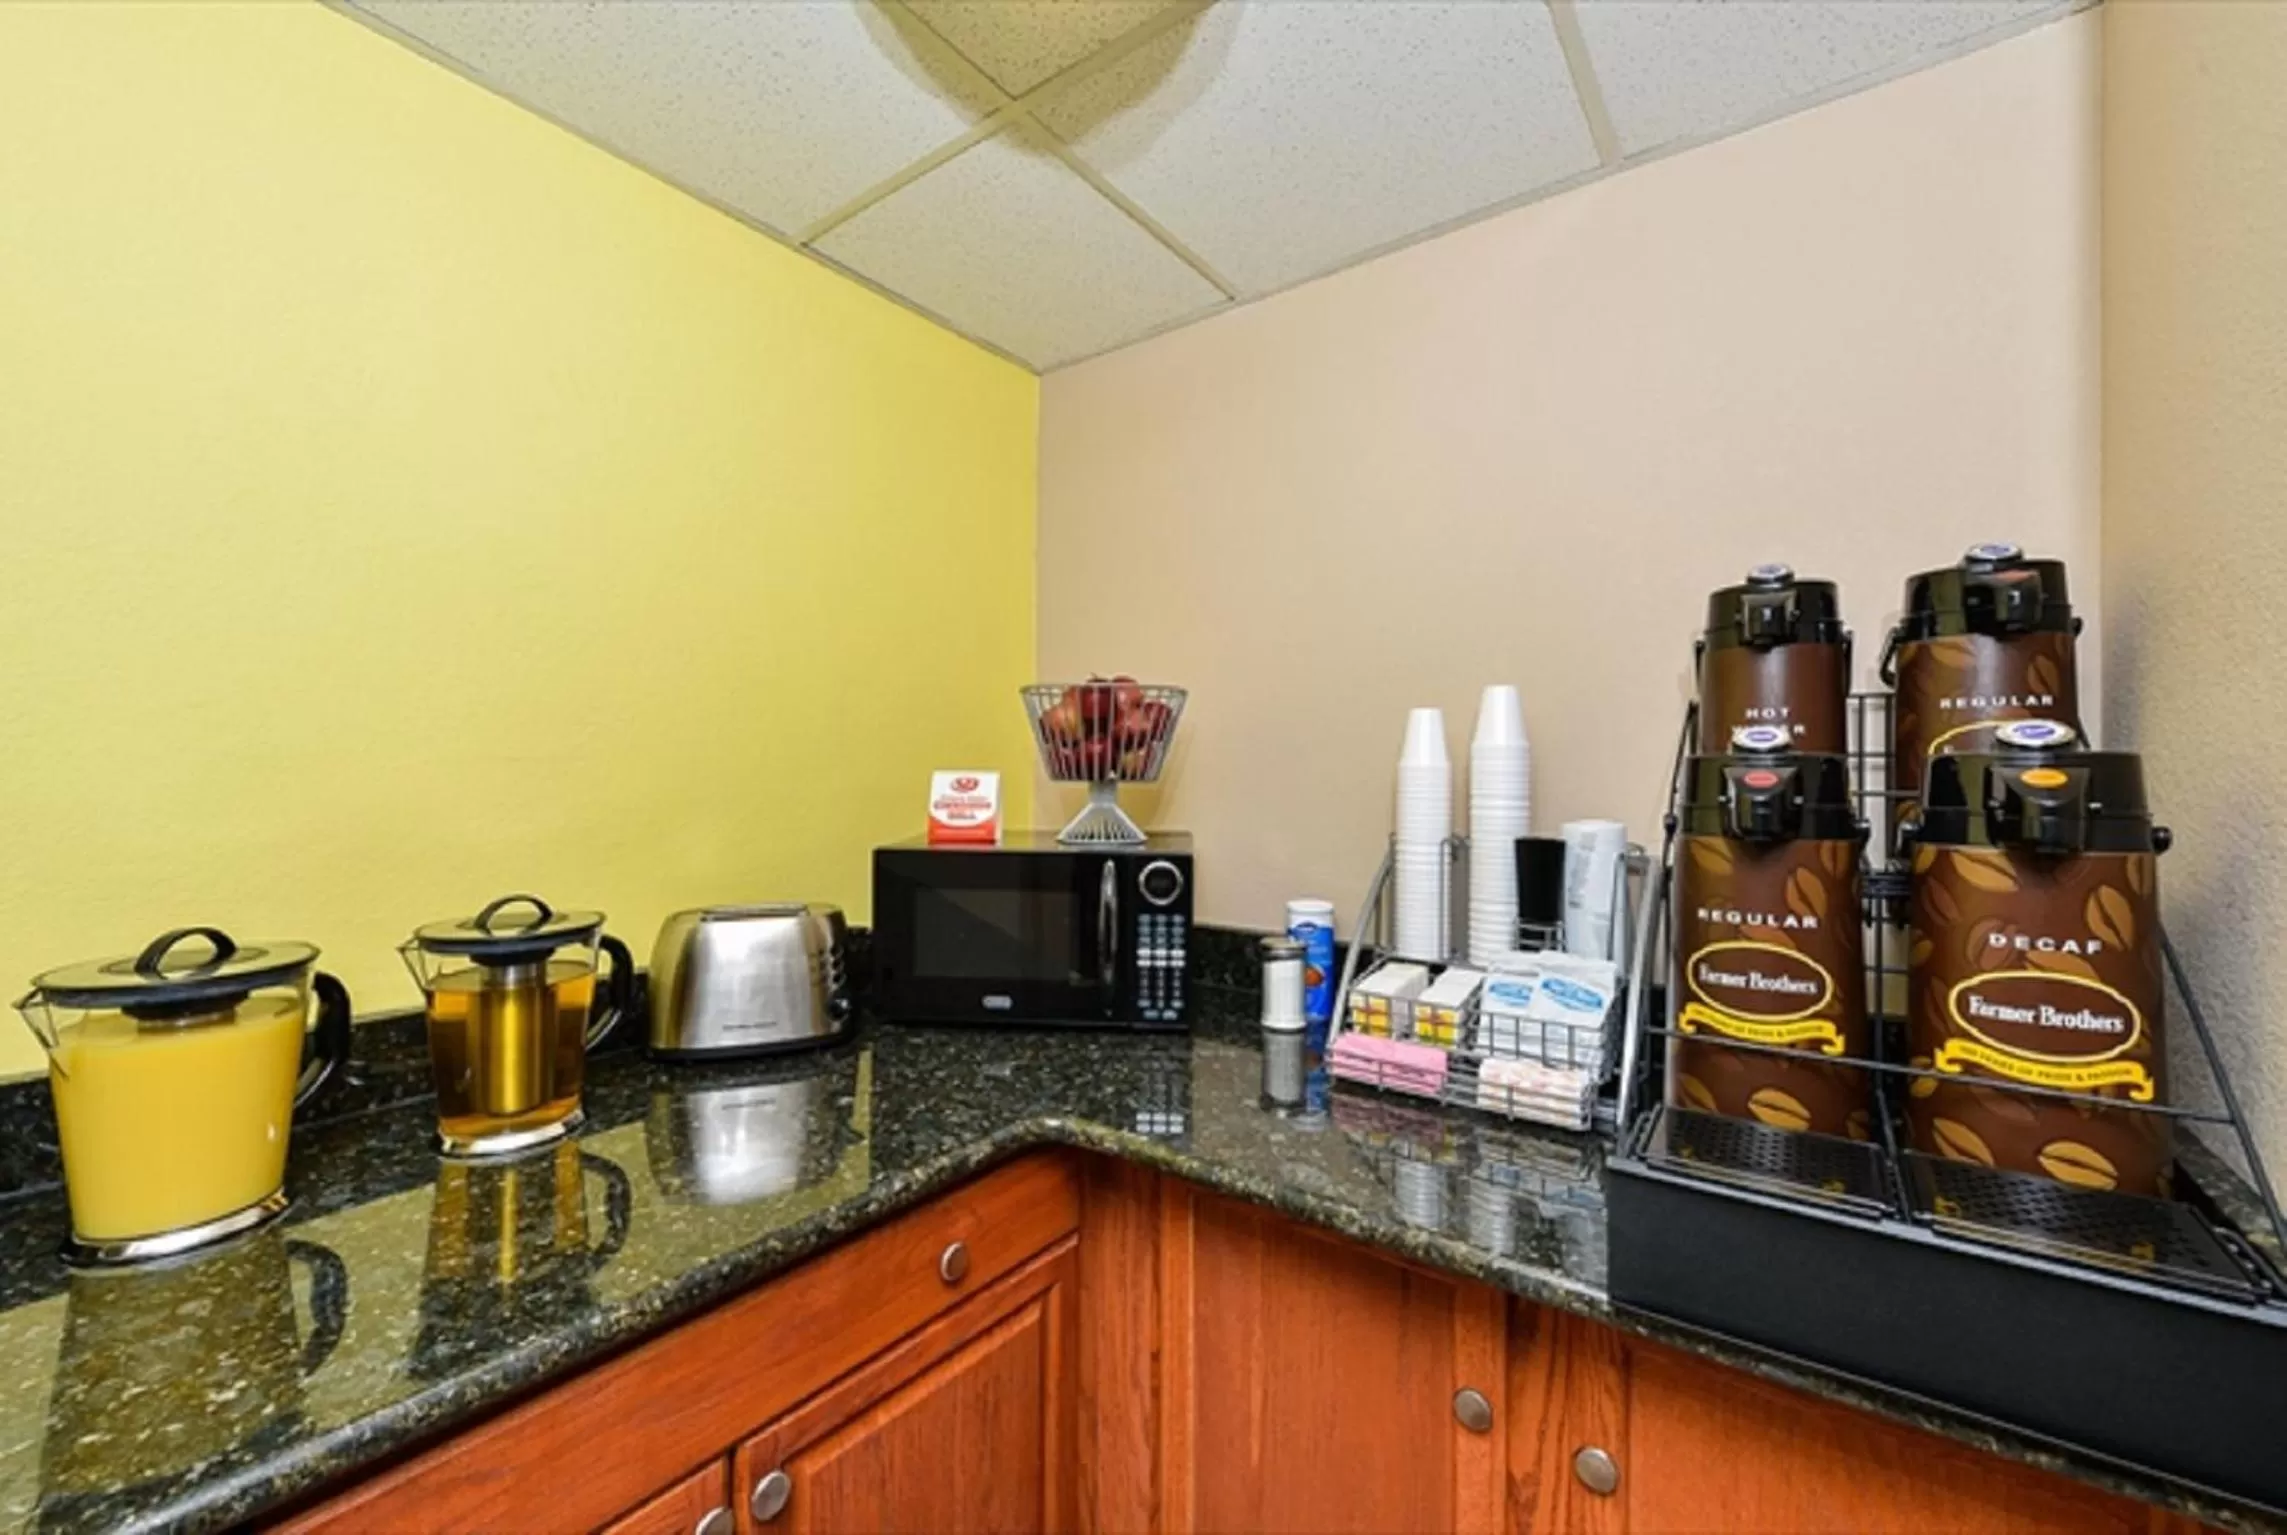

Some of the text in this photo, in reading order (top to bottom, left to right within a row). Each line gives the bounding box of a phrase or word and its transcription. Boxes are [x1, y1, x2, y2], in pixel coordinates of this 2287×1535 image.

[1939, 693, 2053, 709] REGULAR
[1745, 707, 1789, 719] HOT
[1697, 907, 1818, 929] REGULAR
[1988, 932, 2103, 955] DECAF
[1699, 962, 1818, 994] Farmer Brothers
[1967, 994, 2125, 1034] Farmer Brothers
